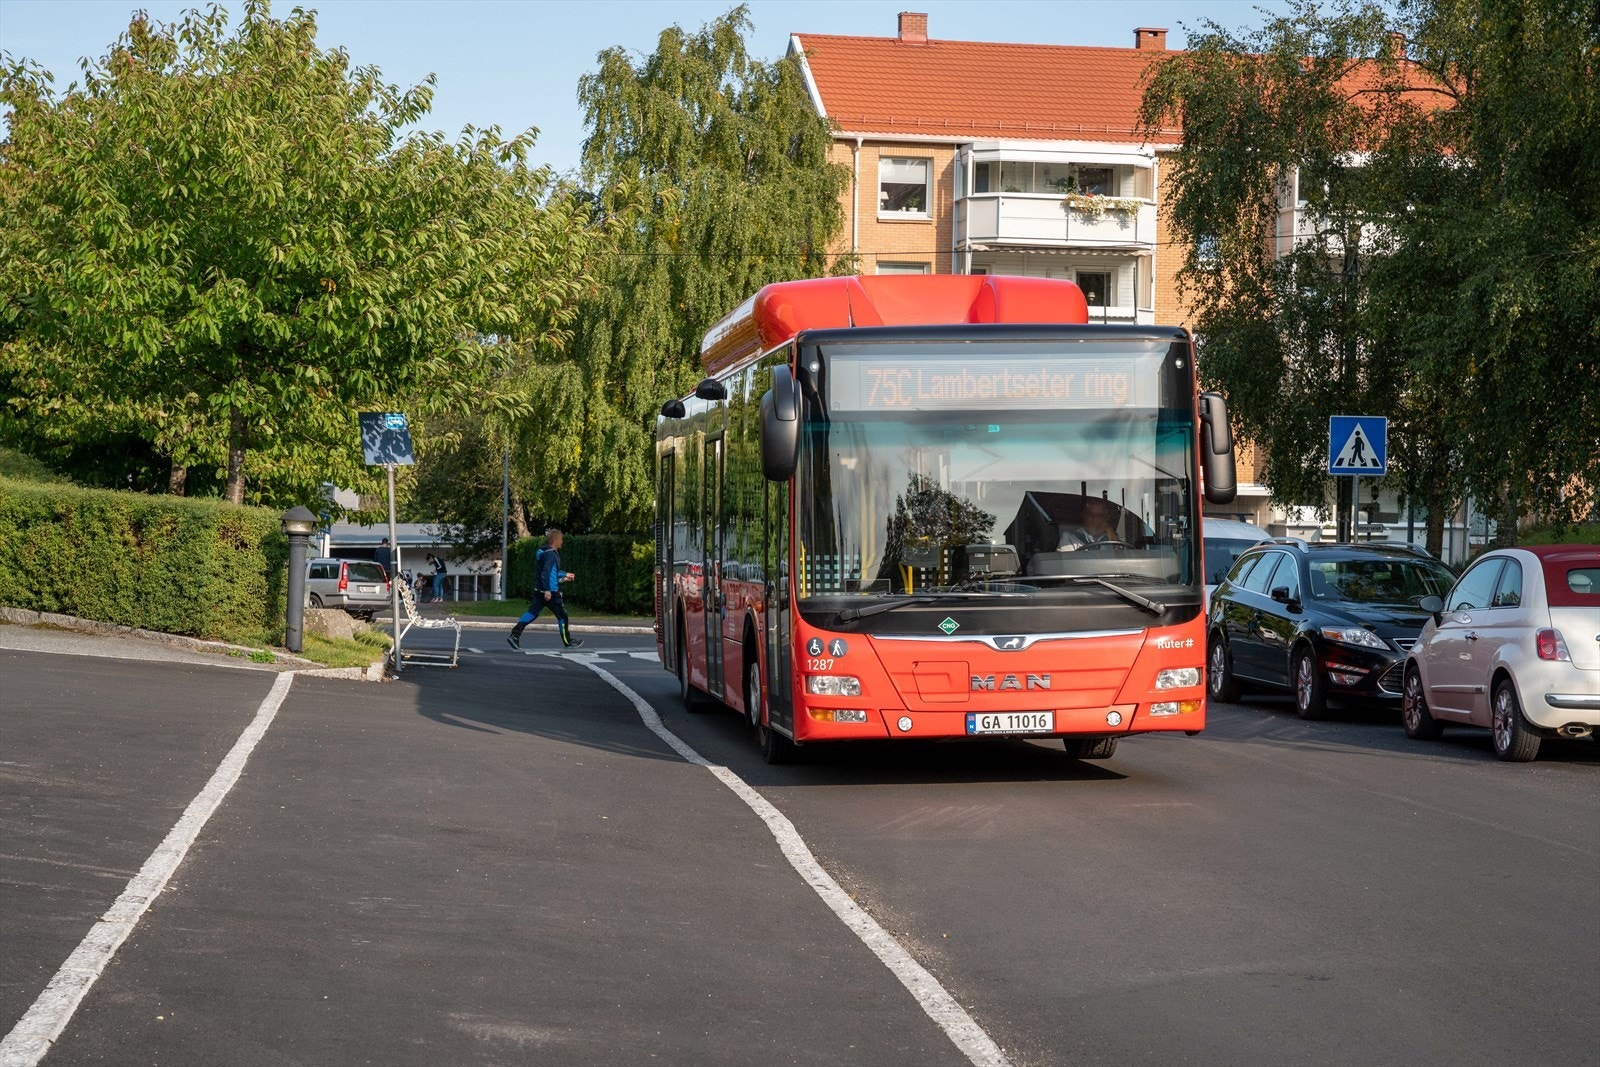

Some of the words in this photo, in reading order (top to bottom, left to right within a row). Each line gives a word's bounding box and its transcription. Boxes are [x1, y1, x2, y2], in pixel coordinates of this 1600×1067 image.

[867, 368, 912, 407] 75C
[917, 367, 1074, 399] Lambertseter
[1085, 368, 1127, 405] ring
[1157, 638, 1194, 649] Ruter#
[807, 659, 834, 670] 1287
[971, 674, 1051, 691] MAN
[981, 715, 1001, 729] GA
[1007, 714, 1047, 729] 11016
